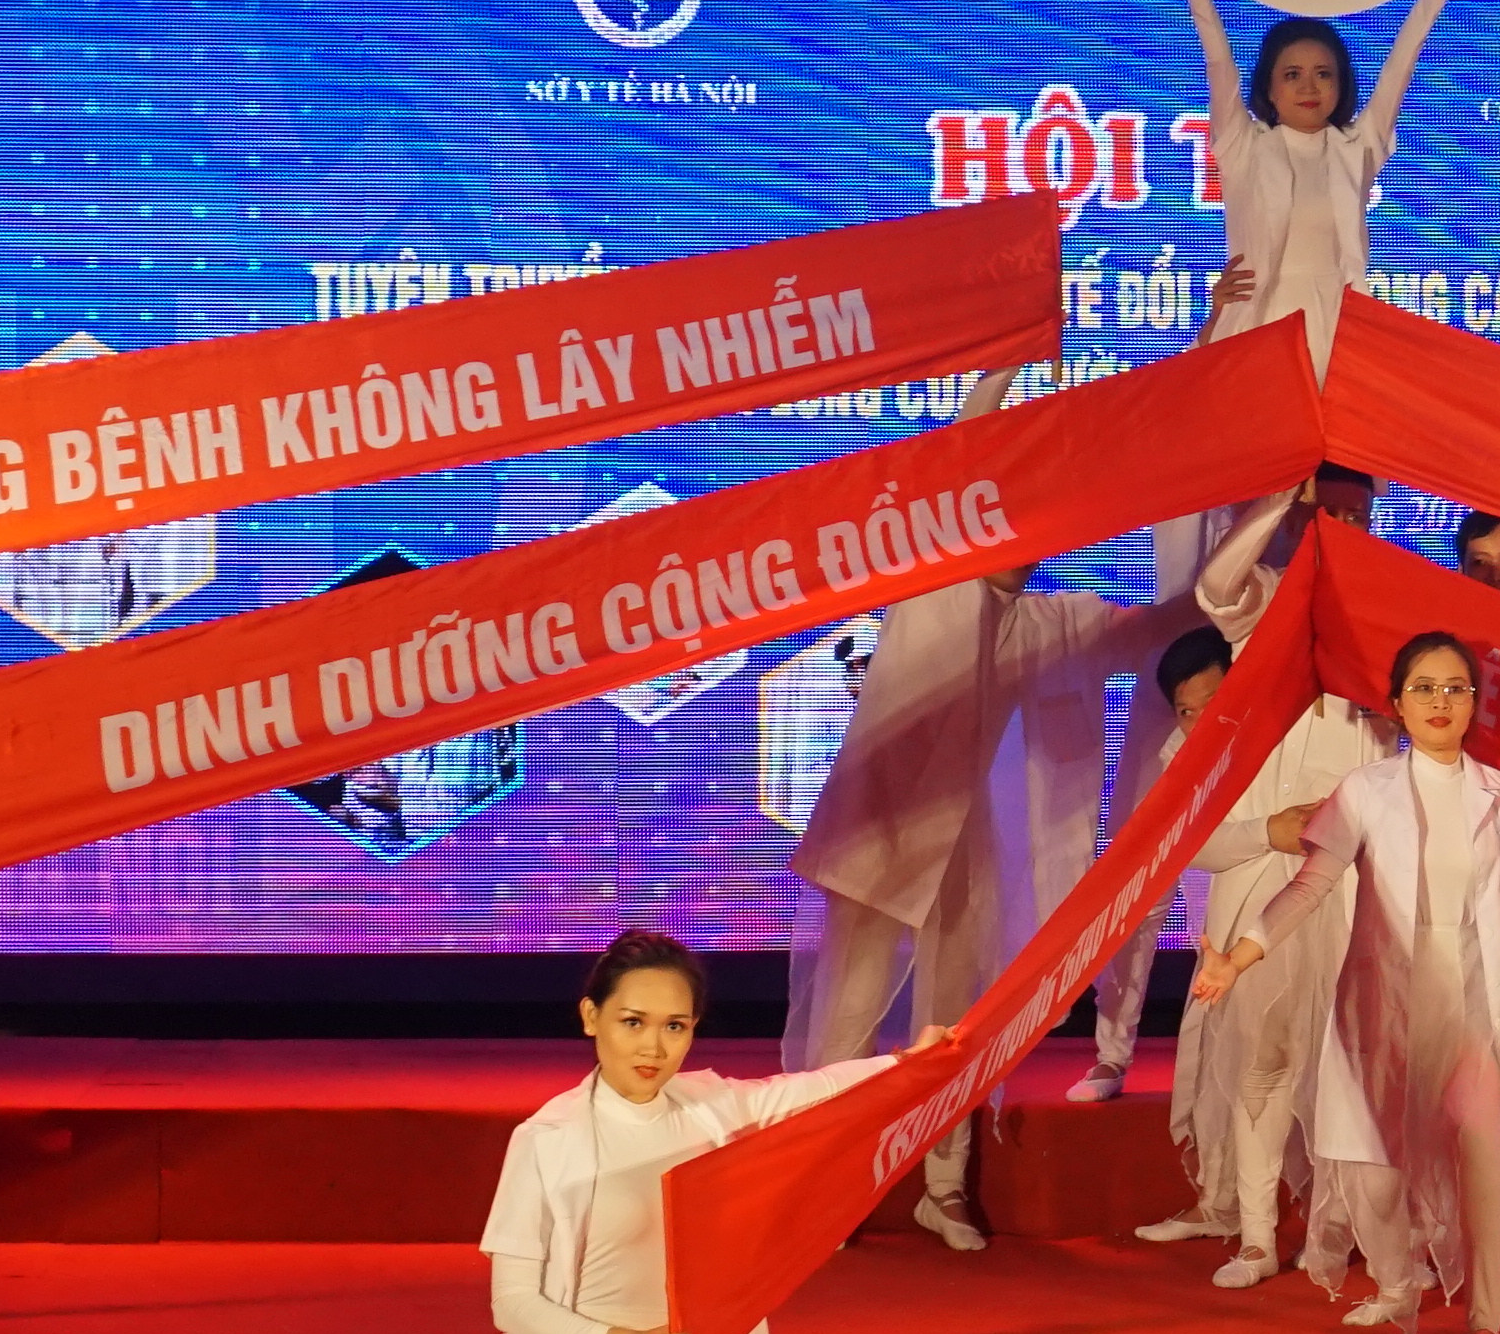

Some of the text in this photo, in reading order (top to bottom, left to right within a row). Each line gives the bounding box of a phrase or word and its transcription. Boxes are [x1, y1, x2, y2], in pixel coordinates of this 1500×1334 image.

[576, 81, 598, 101] Y
[700, 75, 756, 111] NỘI
[927, 84, 1148, 232] HỘI
[48, 405, 242, 511] BỆNH
[261, 364, 504, 467] KHÔNG
[516, 329, 635, 420] LÂY
[656, 275, 875, 394] NHIỄM
[100, 479, 1019, 793] DINH DƯỠNG CỘNG ĐỒNG
